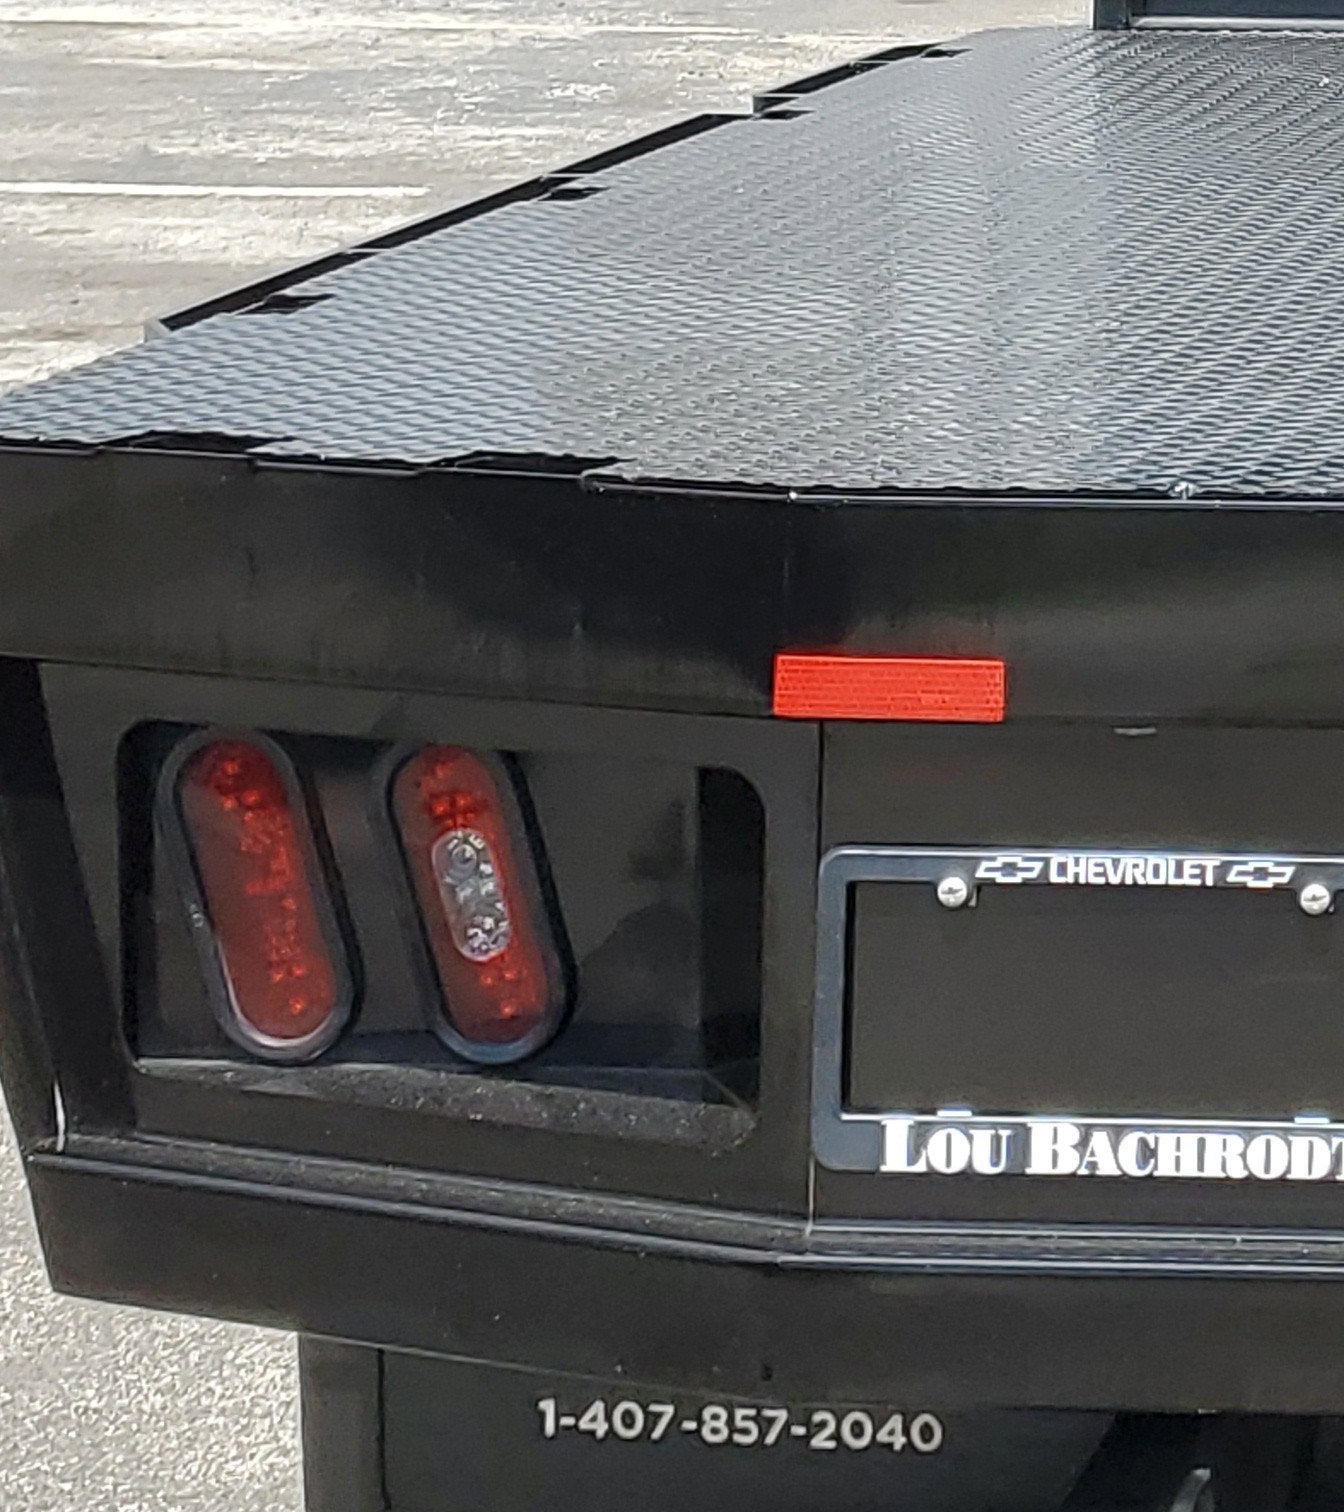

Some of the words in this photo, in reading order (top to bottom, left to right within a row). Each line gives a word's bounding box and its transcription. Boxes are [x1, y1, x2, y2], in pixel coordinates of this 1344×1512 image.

[1048, 856, 1221, 886] CHEVROLET
[879, 1119, 1011, 1175] LOU
[537, 1397, 943, 1452] 1-407-857-2040
